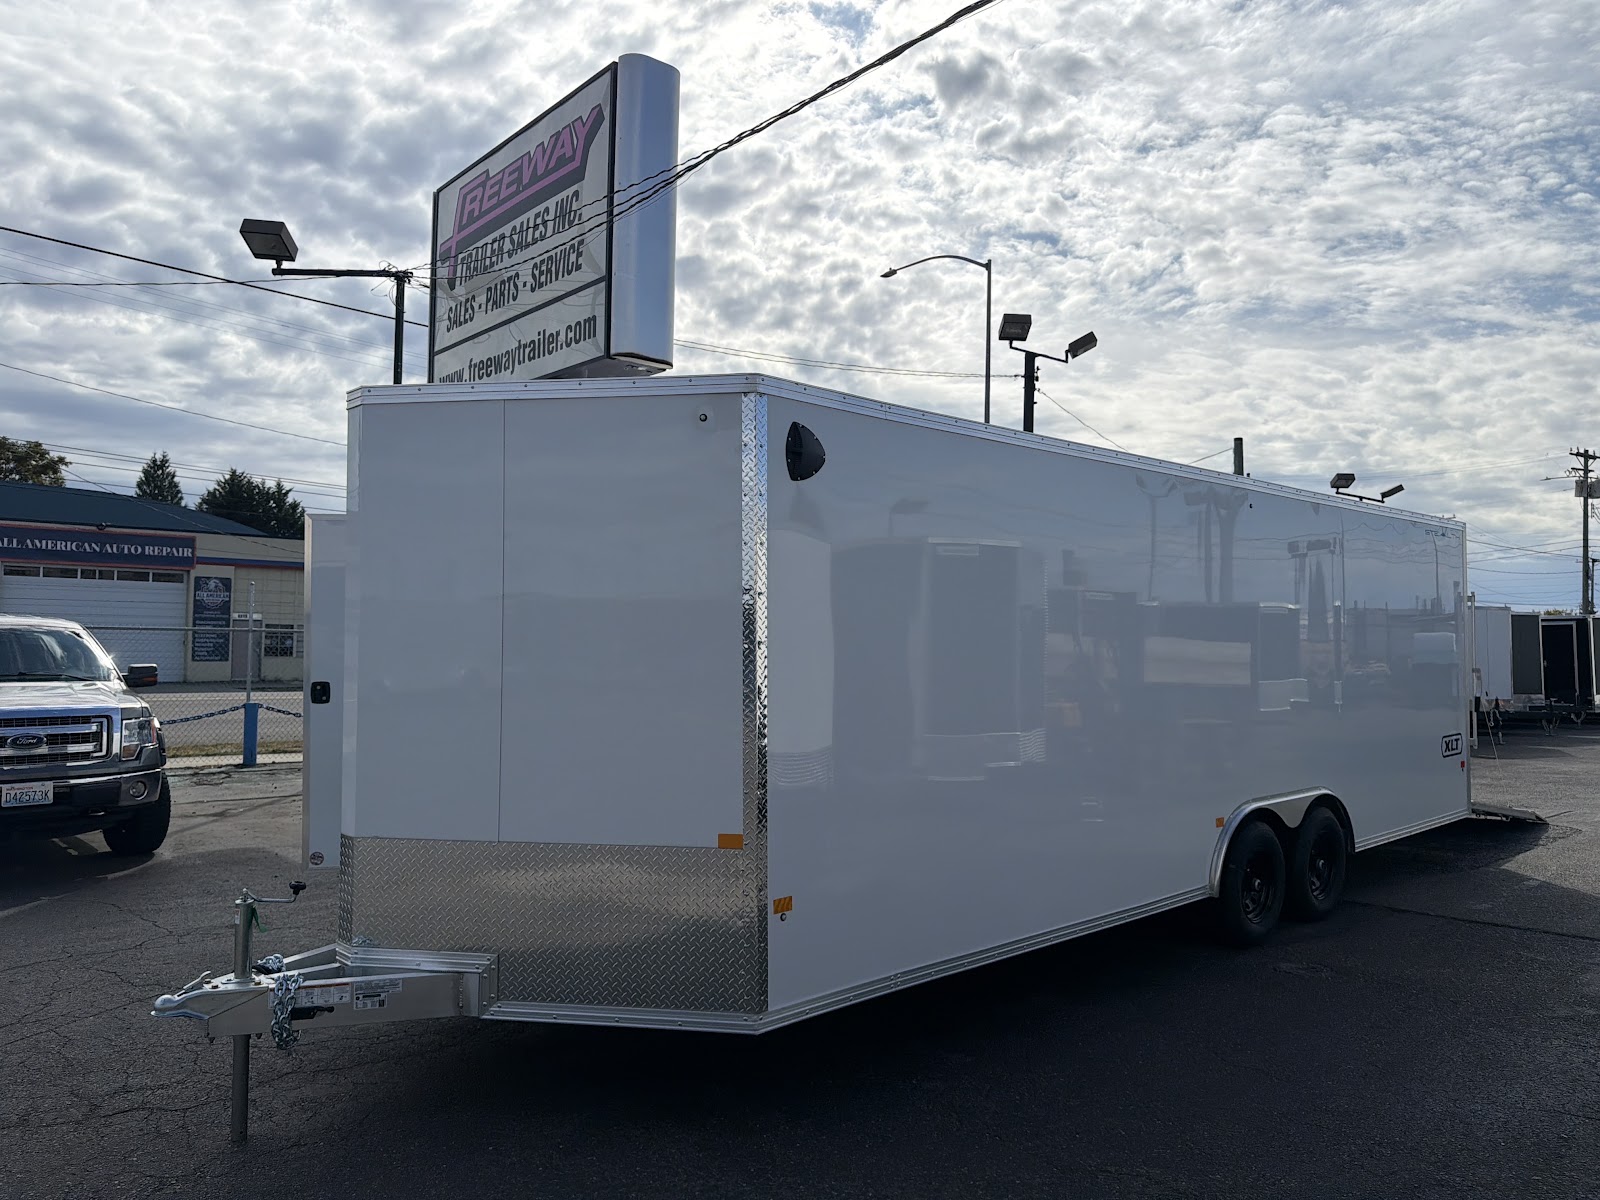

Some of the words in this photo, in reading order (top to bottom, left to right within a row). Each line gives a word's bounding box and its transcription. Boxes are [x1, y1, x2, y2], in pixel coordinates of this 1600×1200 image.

[439, 103, 605, 289] FREEWAY
[459, 231, 506, 286] TRAILER
[508, 206, 550, 259] SALES
[552, 189, 583, 232] INC.
[446, 294, 476, 333] SALES
[485, 271, 520, 315] PARTS
[530, 238, 585, 293] SERVICE
[21, 538, 100, 553] AMERICAN
[103, 543, 142, 555] AUTO
[145, 545, 193, 557] REPAIR
[17, 737, 38, 745] Ford
[1444, 738, 1460, 753] XLT
[5, 789, 50, 804] D42573K
